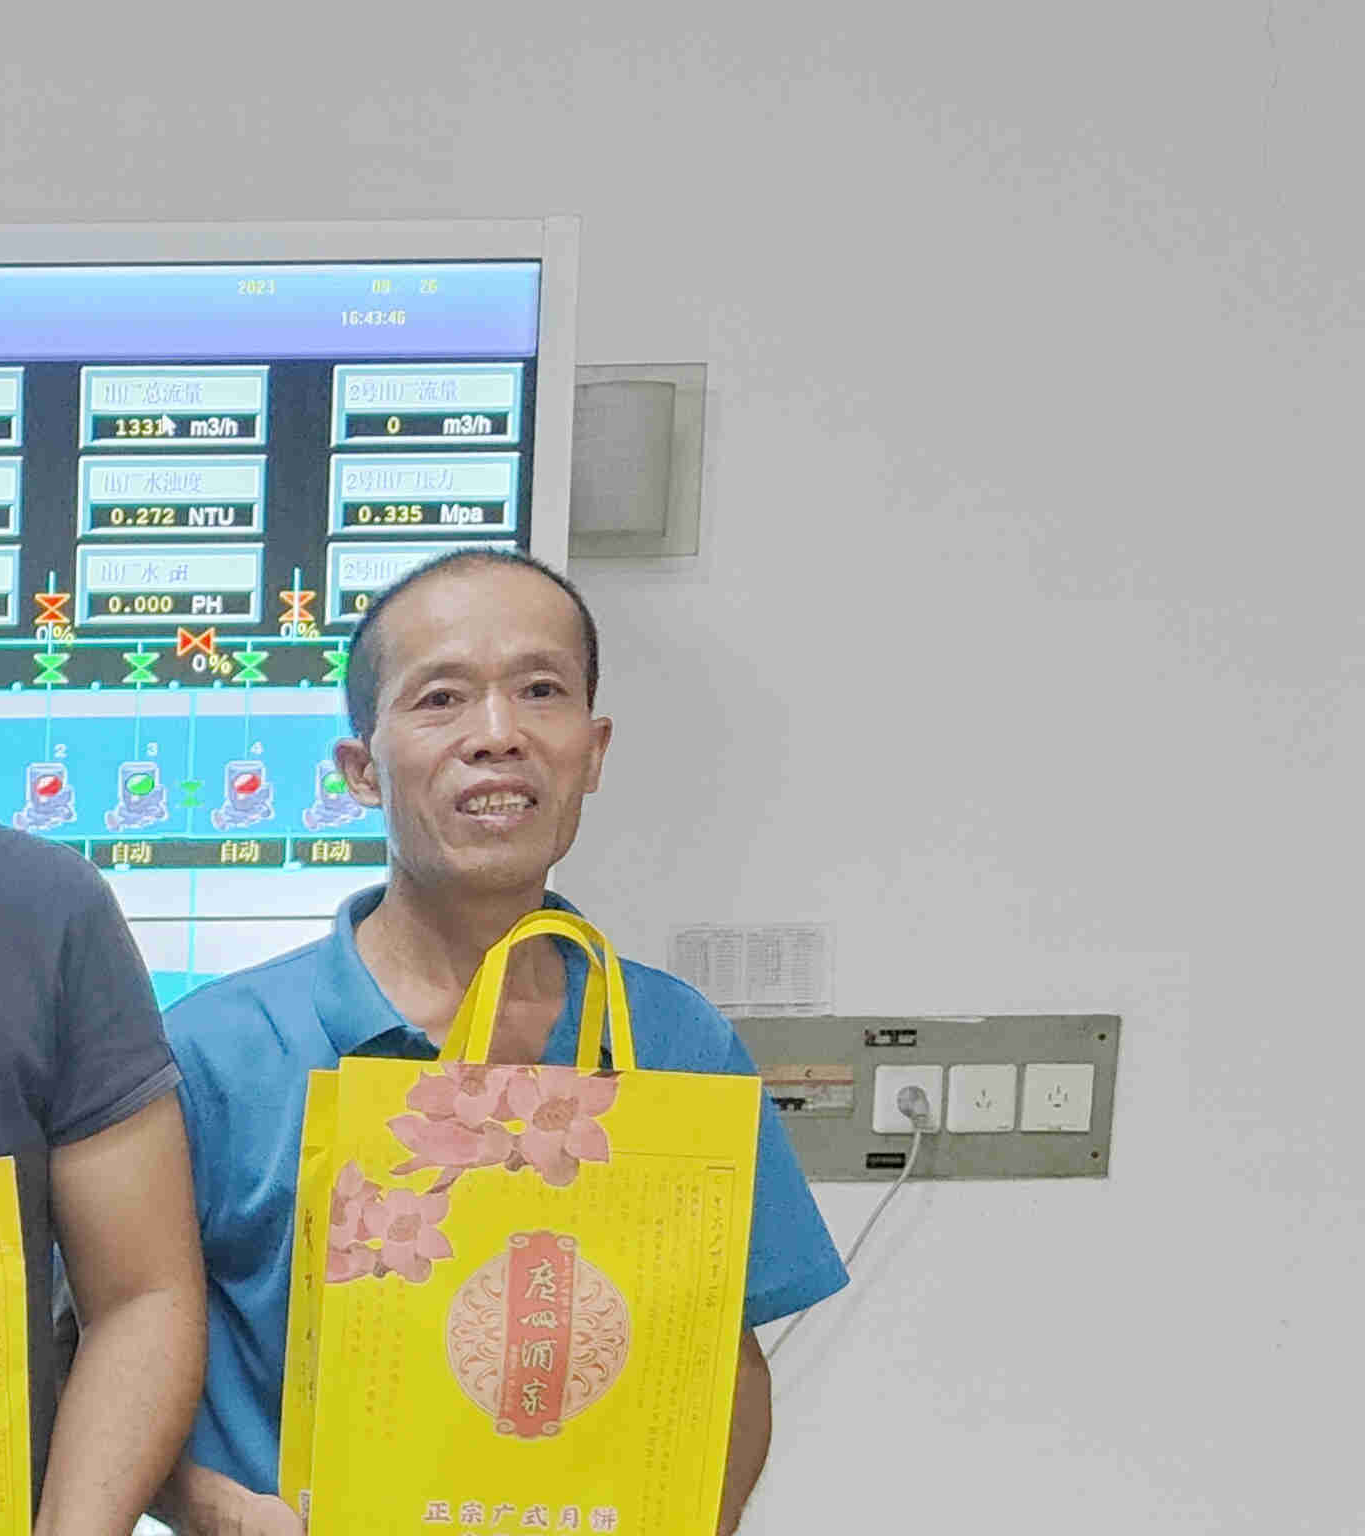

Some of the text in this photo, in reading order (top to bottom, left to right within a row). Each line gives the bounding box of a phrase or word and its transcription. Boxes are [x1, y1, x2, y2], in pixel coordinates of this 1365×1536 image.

[189, 417, 239, 437] m3/h
[386, 415, 492, 435] 0 m3/h
[109, 507, 235, 526] 0.272 NTU
[357, 503, 484, 524] 0.335 Mpa
[108, 595, 223, 615] 0.000 PH
[191, 653, 233, 676] 0%
[54, 743, 67, 758] 2
[146, 741, 159, 757] 3
[250, 740, 264, 755] 4
[111, 842, 153, 864] 自动
[220, 840, 260, 863] 自动
[311, 839, 353, 862] 自动
[422, 1500, 618, 1532] 正宗广式月饼
